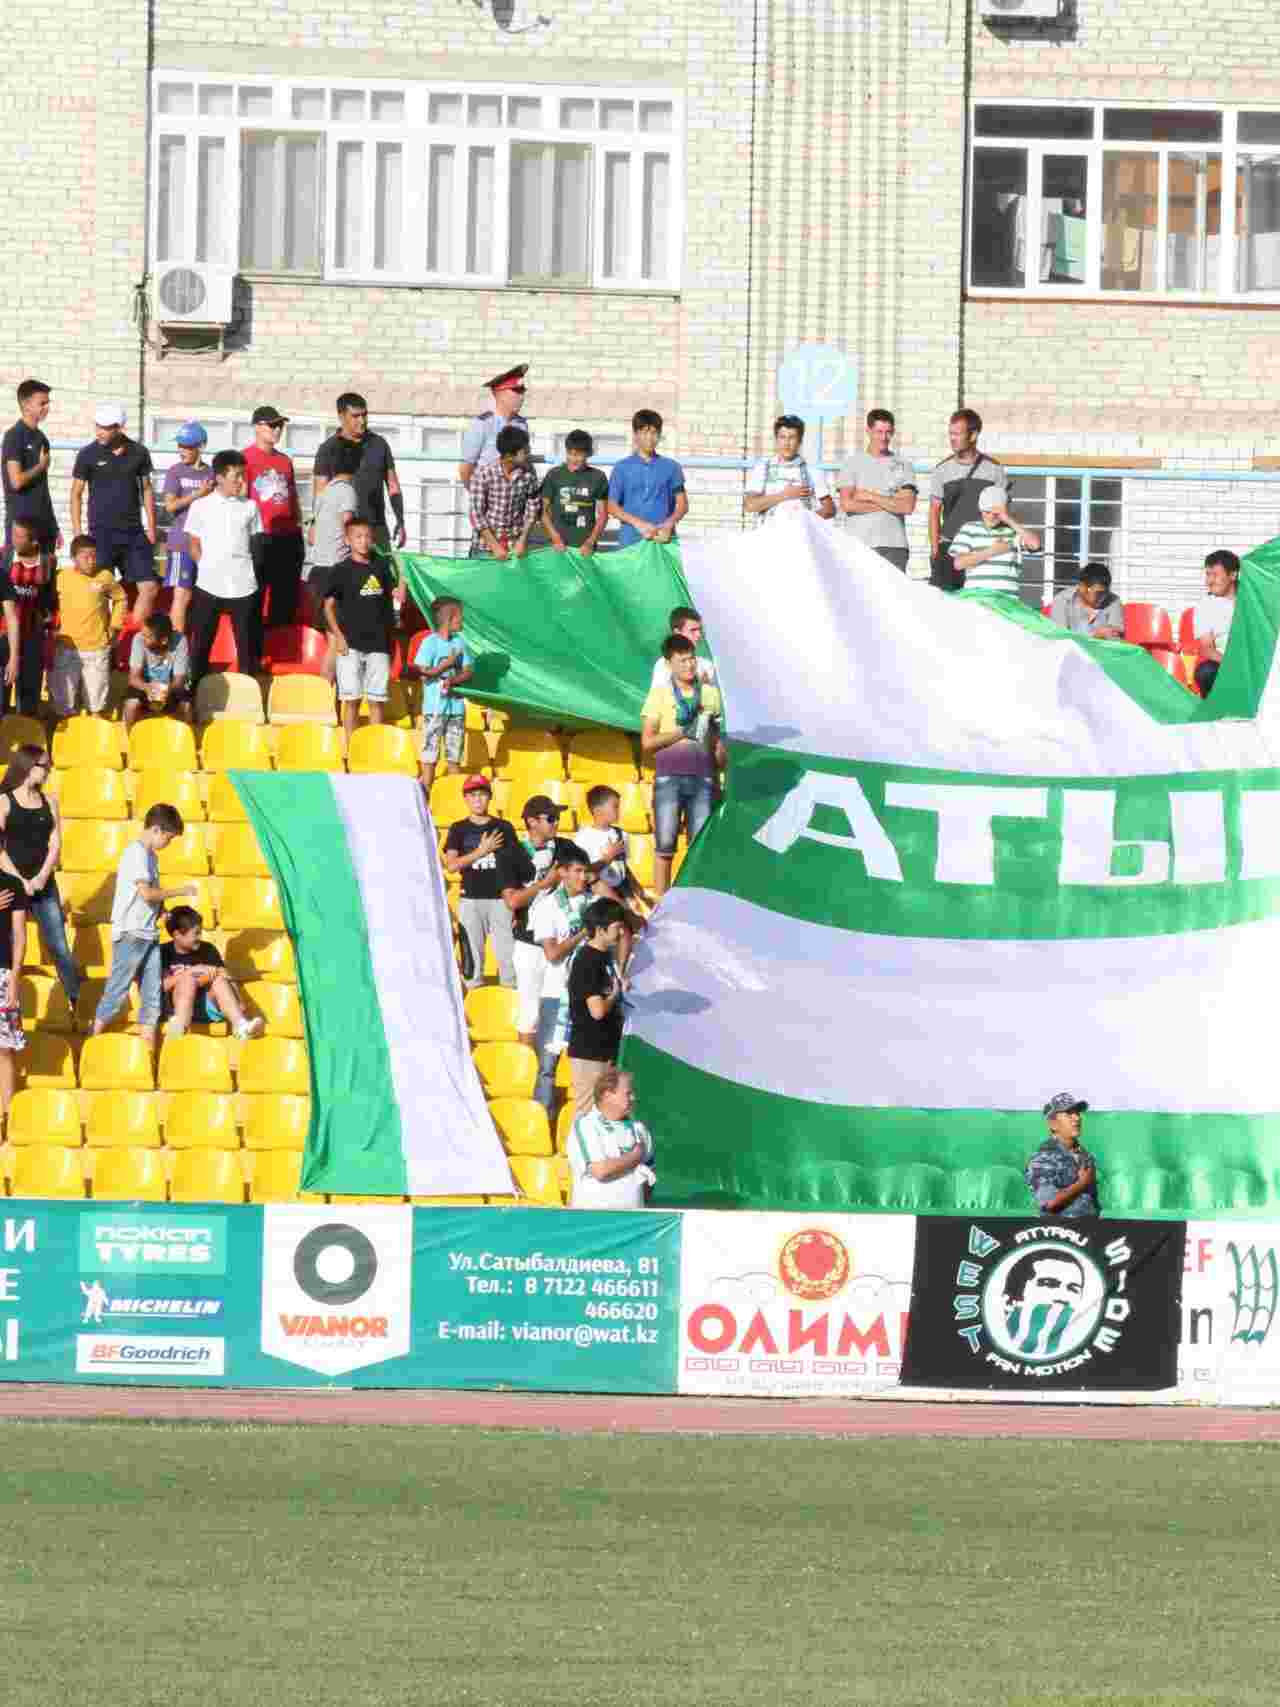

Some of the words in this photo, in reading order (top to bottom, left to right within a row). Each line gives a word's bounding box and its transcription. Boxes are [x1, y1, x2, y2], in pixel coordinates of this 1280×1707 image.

[96, 1243, 212, 1264] TYRES
[637, 1257, 659, 1274] 81
[465, 1275, 513, 1294] Тел.:
[525, 1277, 537, 1294] 8
[543, 1278, 586, 1296] 7122
[592, 1280, 658, 1297] 466611
[953, 1224, 1001, 1354] WEST
[1093, 1236, 1132, 1352] SIDE
[110, 1299, 220, 1315] MICHELIN
[585, 1301, 658, 1320] 466620
[279, 1314, 389, 1337] VIANOR
[438, 1320, 505, 1340] E-mail:
[512, 1322, 658, 1347] vianor@wat.kz
[687, 1303, 912, 1357] ОЛИМ
[89, 1344, 211, 1361] BFGoodrich
[1024, 1349, 1092, 1376] MOTION
